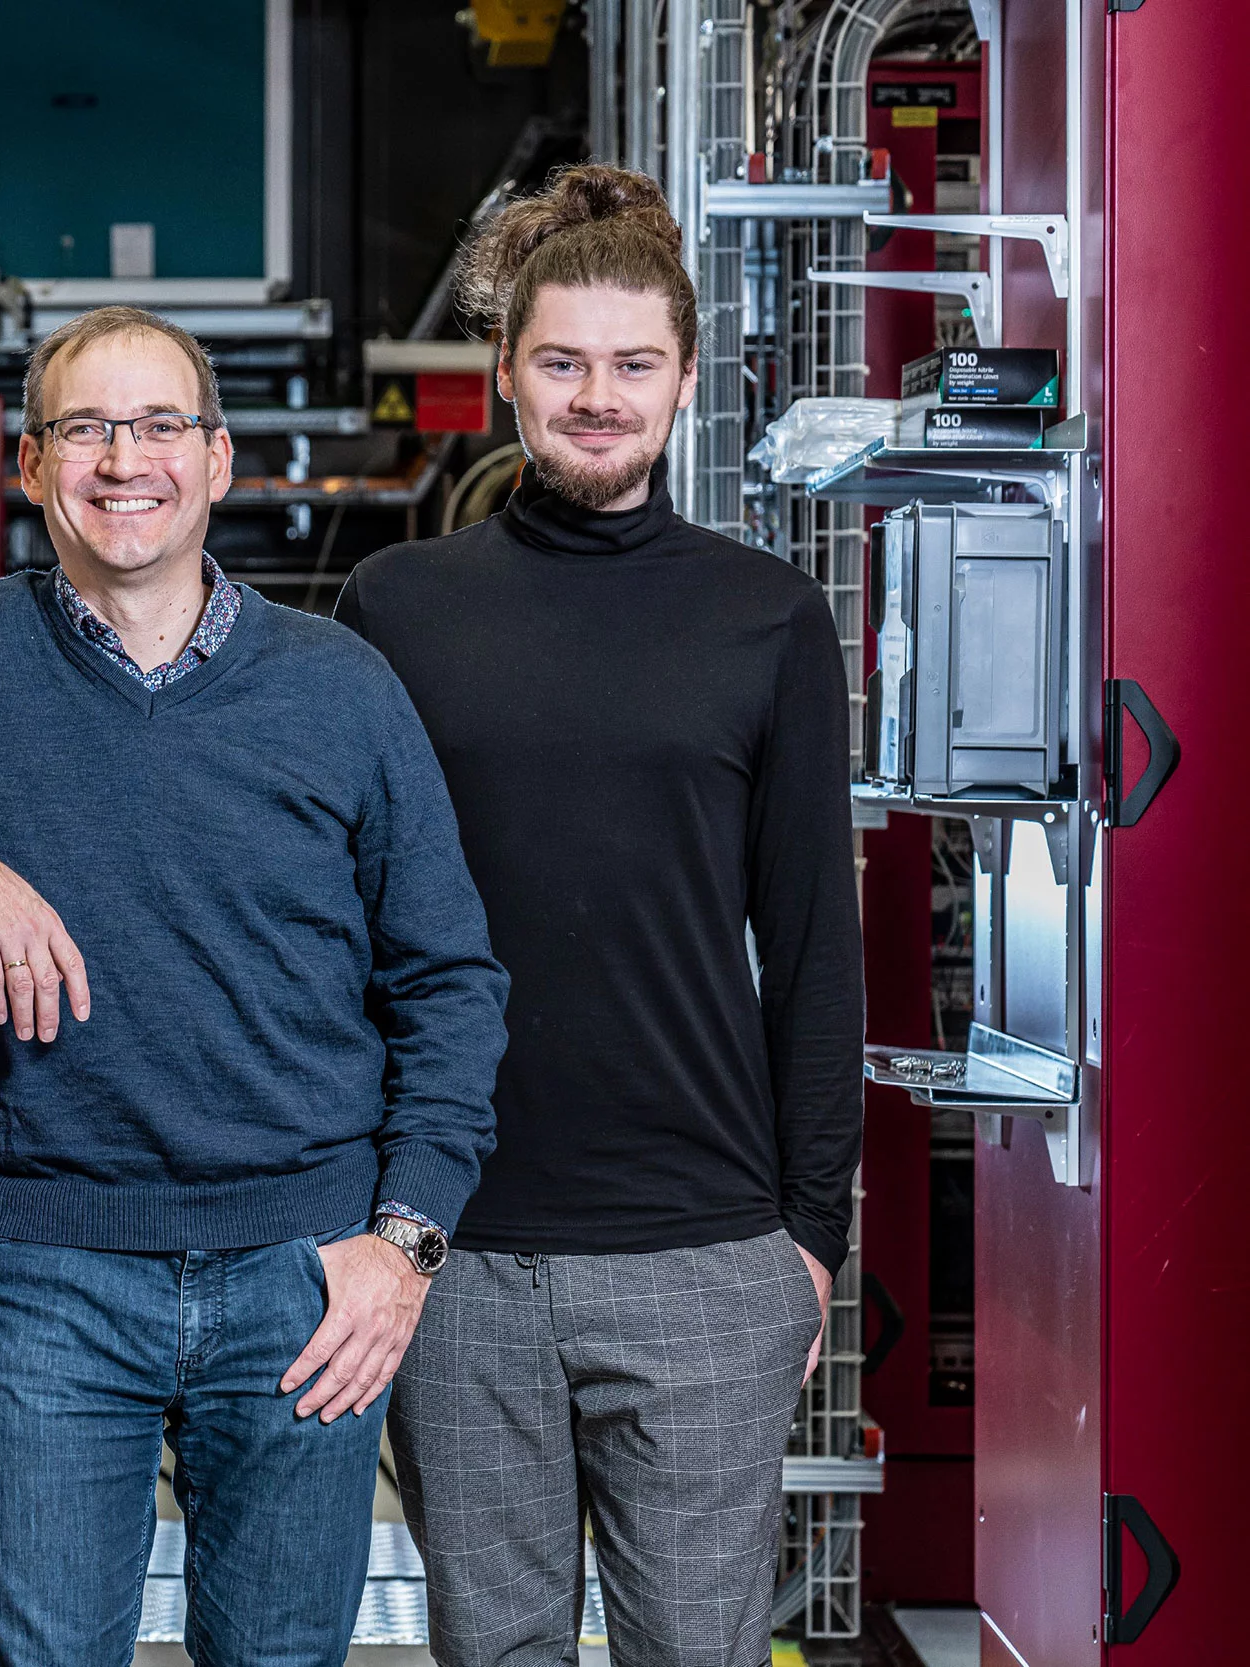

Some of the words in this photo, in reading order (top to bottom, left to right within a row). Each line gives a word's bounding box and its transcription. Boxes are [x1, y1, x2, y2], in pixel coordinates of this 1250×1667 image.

[949, 353, 978, 366] 100
[1045, 387, 1052, 396] L
[932, 413, 962, 427] 100
